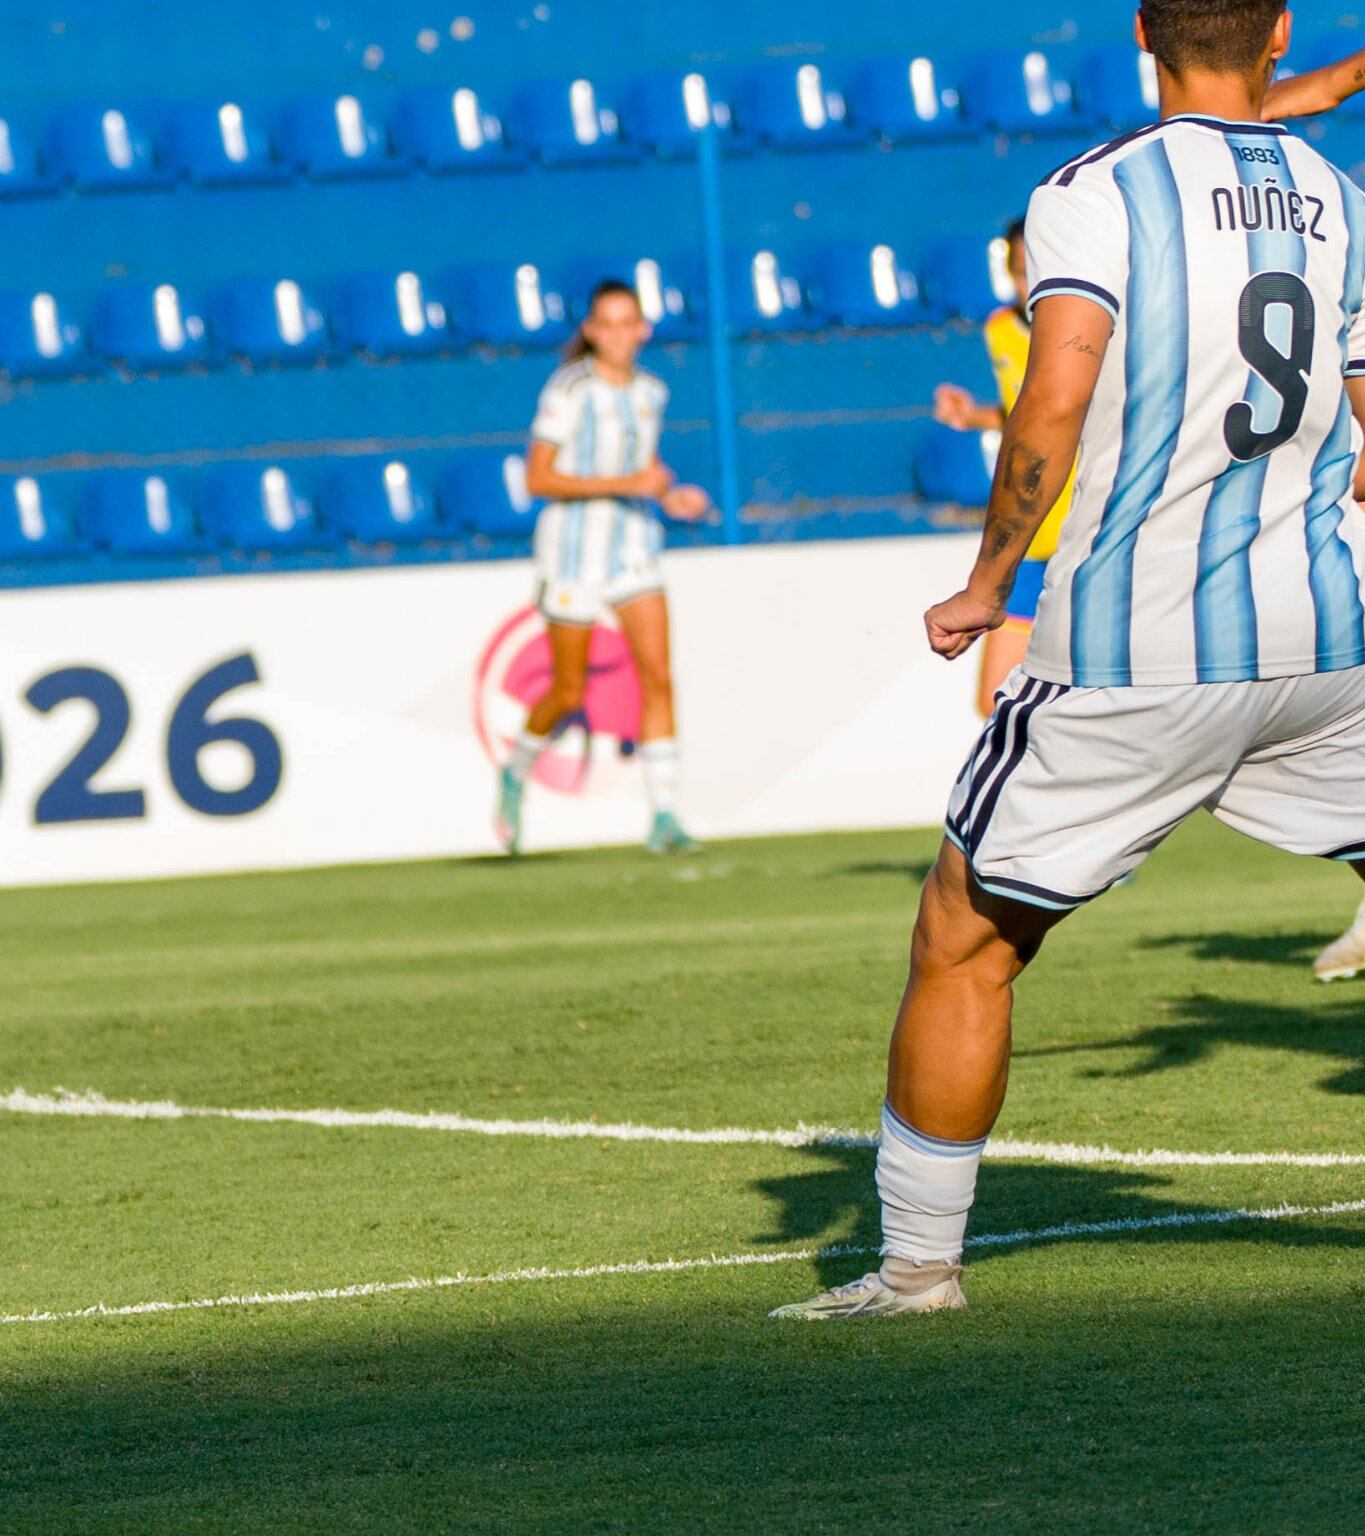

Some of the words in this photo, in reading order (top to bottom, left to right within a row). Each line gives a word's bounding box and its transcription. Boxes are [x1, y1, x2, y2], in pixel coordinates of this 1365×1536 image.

[1233, 146, 1280, 165] 1893
[1211, 177, 1327, 242] NUÑEZ
[0, 648, 284, 826] 26
